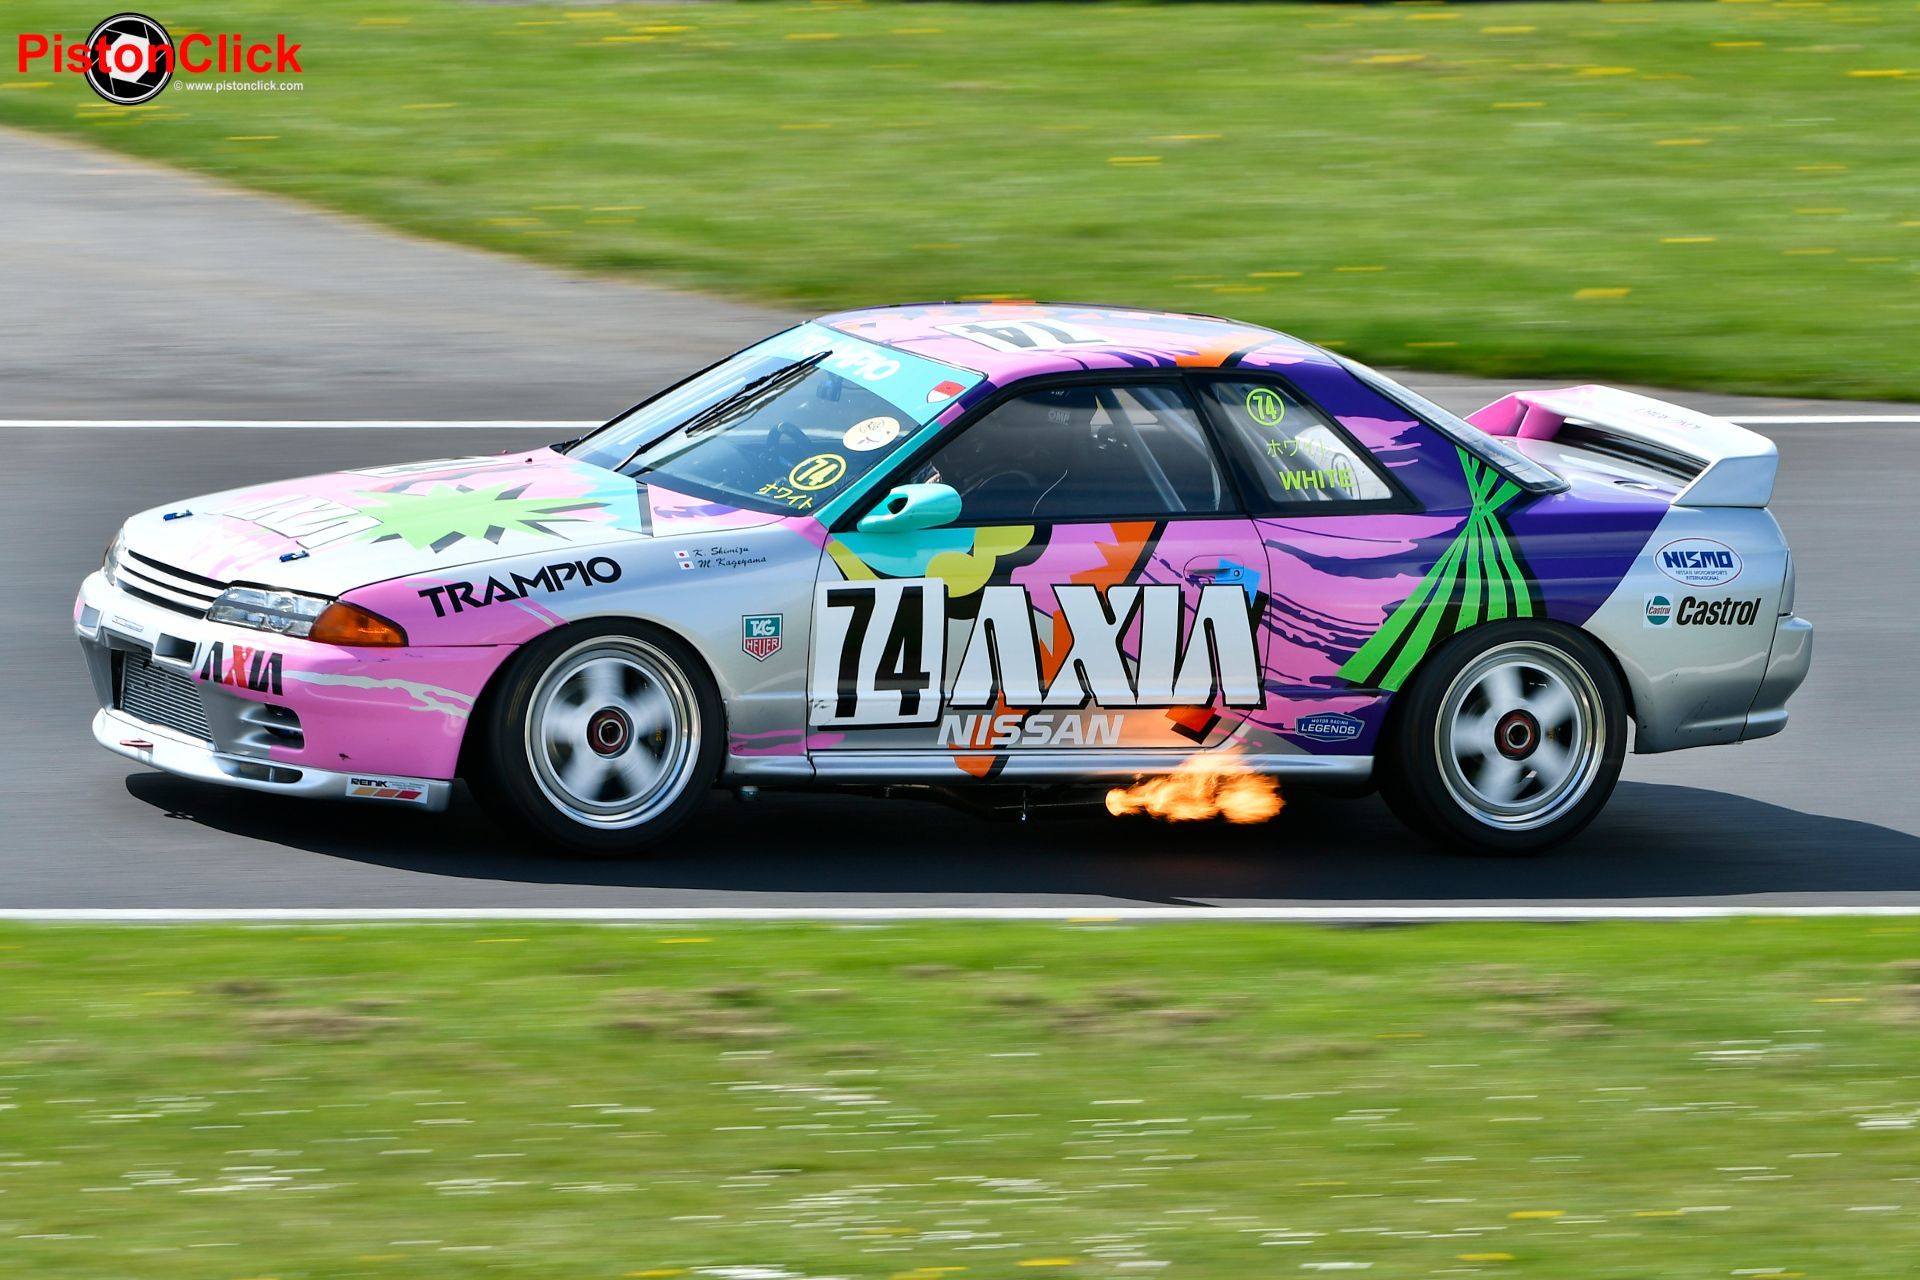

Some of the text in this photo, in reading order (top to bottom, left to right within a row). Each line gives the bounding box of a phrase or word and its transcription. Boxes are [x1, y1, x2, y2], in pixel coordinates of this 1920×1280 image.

[1252, 394, 1278, 421] 74
[793, 456, 841, 488] 74
[1278, 467, 1355, 491] WHITE
[711, 546, 749, 556] Shimizu
[716, 556, 767, 569] Kageyama
[1662, 551, 1734, 568] NISMO
[418, 556, 622, 618] TRAMPIO
[1648, 606, 1671, 615] Castrol
[1676, 596, 1761, 626] Castrol
[750, 619, 776, 636] TAG
[746, 638, 780, 656] HEUER
[827, 585, 931, 719] 74
[947, 583, 1267, 710] AXIA
[200, 641, 283, 696] AXIA
[937, 714, 1124, 746] NISSAN
[1301, 724, 1356, 735] LEGENDS
